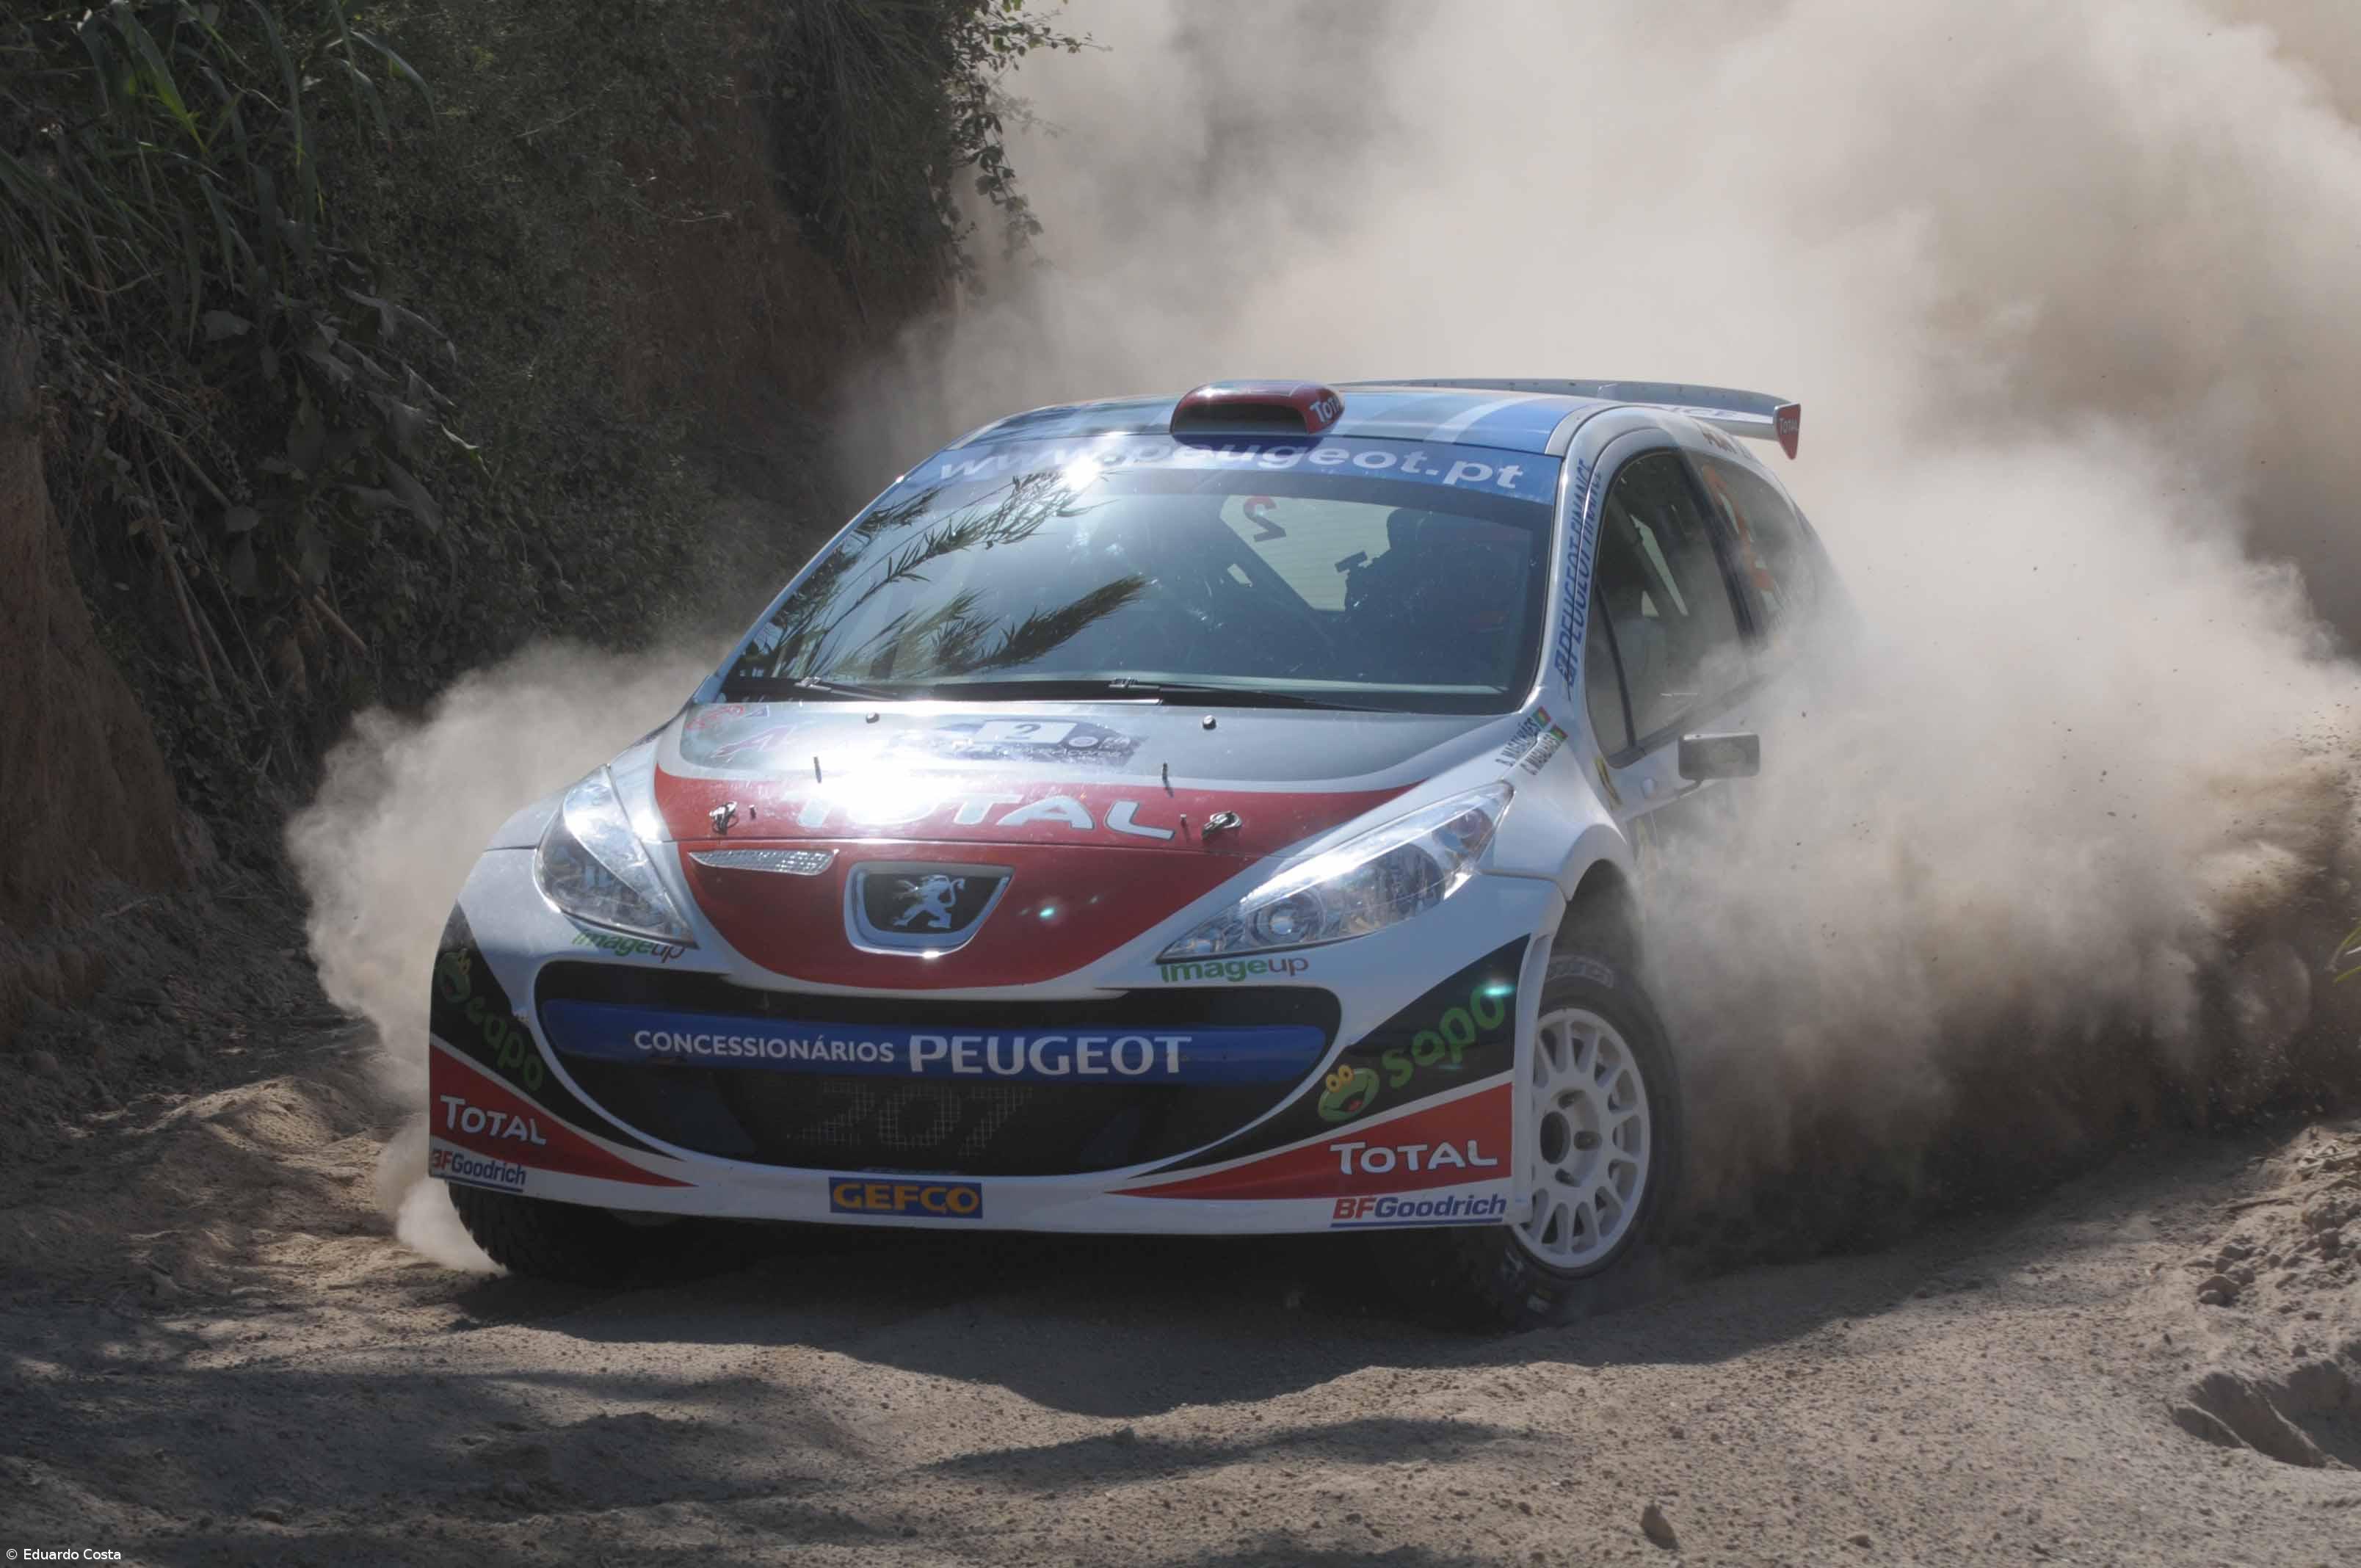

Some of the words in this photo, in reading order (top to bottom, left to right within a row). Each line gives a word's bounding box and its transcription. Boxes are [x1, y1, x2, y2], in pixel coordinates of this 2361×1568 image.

[940, 442, 1523, 489] ww.peugeot.pt
[1571, 458, 1601, 546] FINANCE
[1559, 536, 1589, 663] PEUGEOT
[1160, 957, 1310, 983] imageup
[634, 1030, 895, 1063] CONCESSIONÁRIOS
[909, 1034, 1192, 1075] PEUGEOT
[1381, 984, 1505, 1088] sapo
[440, 1096, 547, 1146] TOTAL
[1329, 1139, 1498, 1175] TOTAL
[833, 1182, 980, 1215] GEFCO
[1332, 1194, 1506, 1220] BFGoodrich
